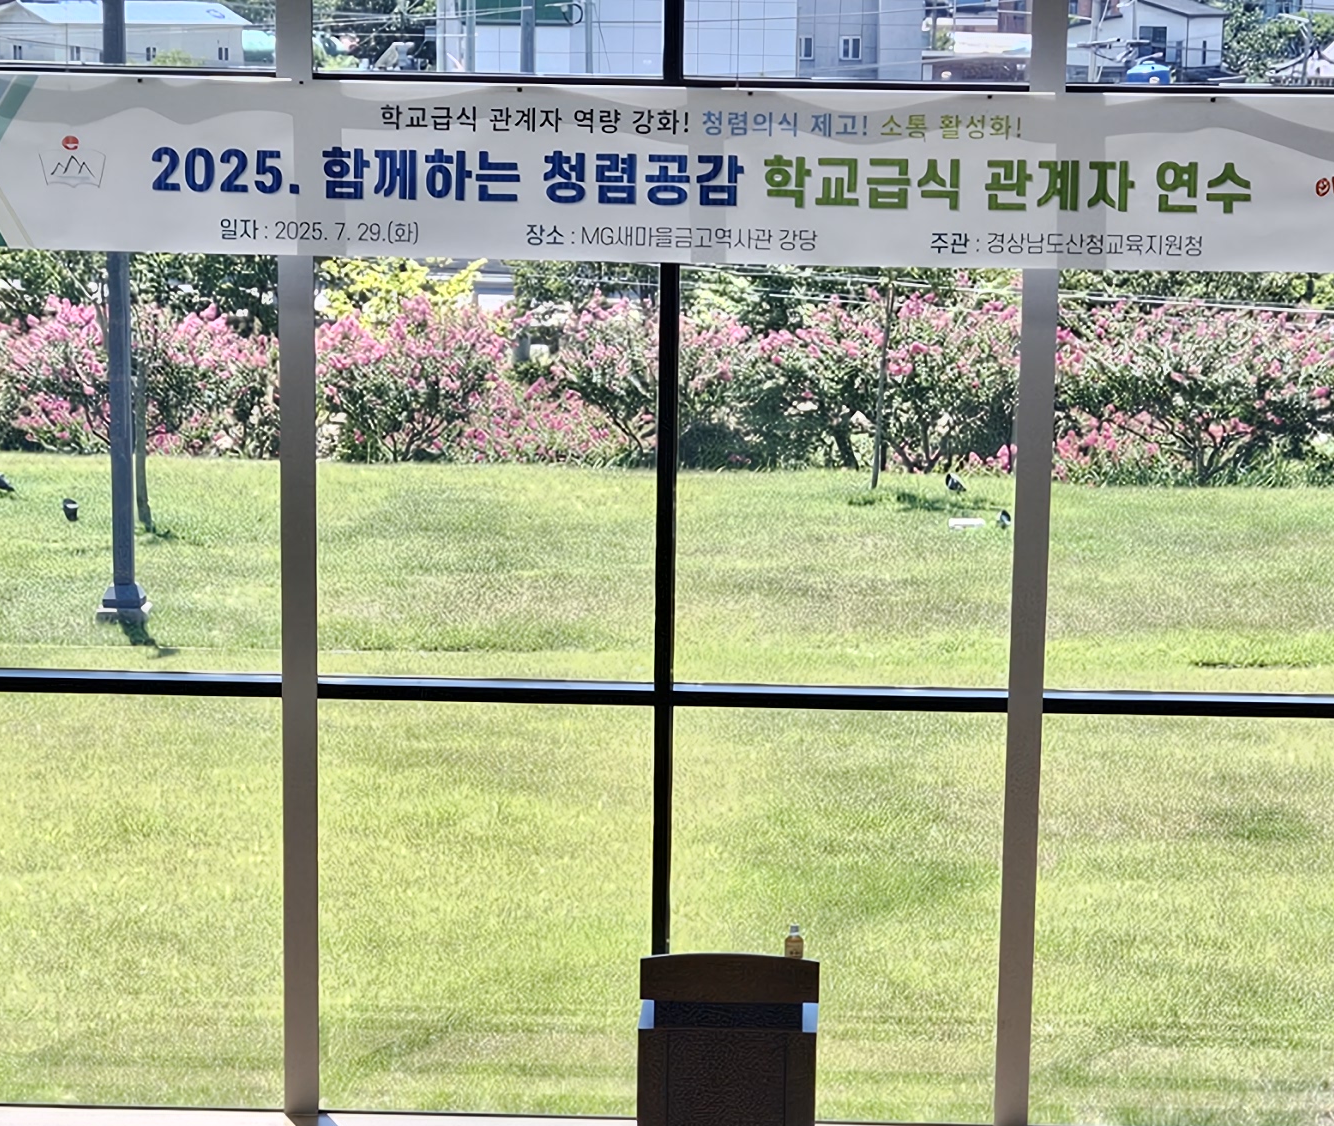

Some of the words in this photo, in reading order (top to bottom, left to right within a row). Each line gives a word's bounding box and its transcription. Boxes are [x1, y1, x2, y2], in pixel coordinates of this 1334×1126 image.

[380, 104, 478, 132] 학교급식
[489, 107, 563, 134] 관계자
[573, 108, 622, 134] 역량
[632, 109, 690, 135] 강화!
[702, 110, 799, 137] 청렴의식
[810, 112, 868, 138] 제고!
[880, 114, 929, 140] 소통
[939, 113, 1022, 140] 활성화!
[151, 146, 300, 195] 2025.
[321, 146, 521, 202] 함께하는
[542, 150, 745, 206] 청렴공감
[763, 154, 961, 211] 학교급식
[984, 159, 1136, 213] 관계자
[1156, 160, 1252, 215] 연수
[220, 218, 259, 241] 일자
[274, 220, 328, 242] 2025.
[334, 222, 351, 242] 7.
[357, 221, 419, 245] 29.(화)
[525, 224, 565, 247] 장소
[581, 226, 773, 250] MG새마을금고역사관
[779, 228, 819, 251] 강당
[930, 231, 970, 254] 주관
[987, 232, 1204, 257] 경상남도산청교육지원청
